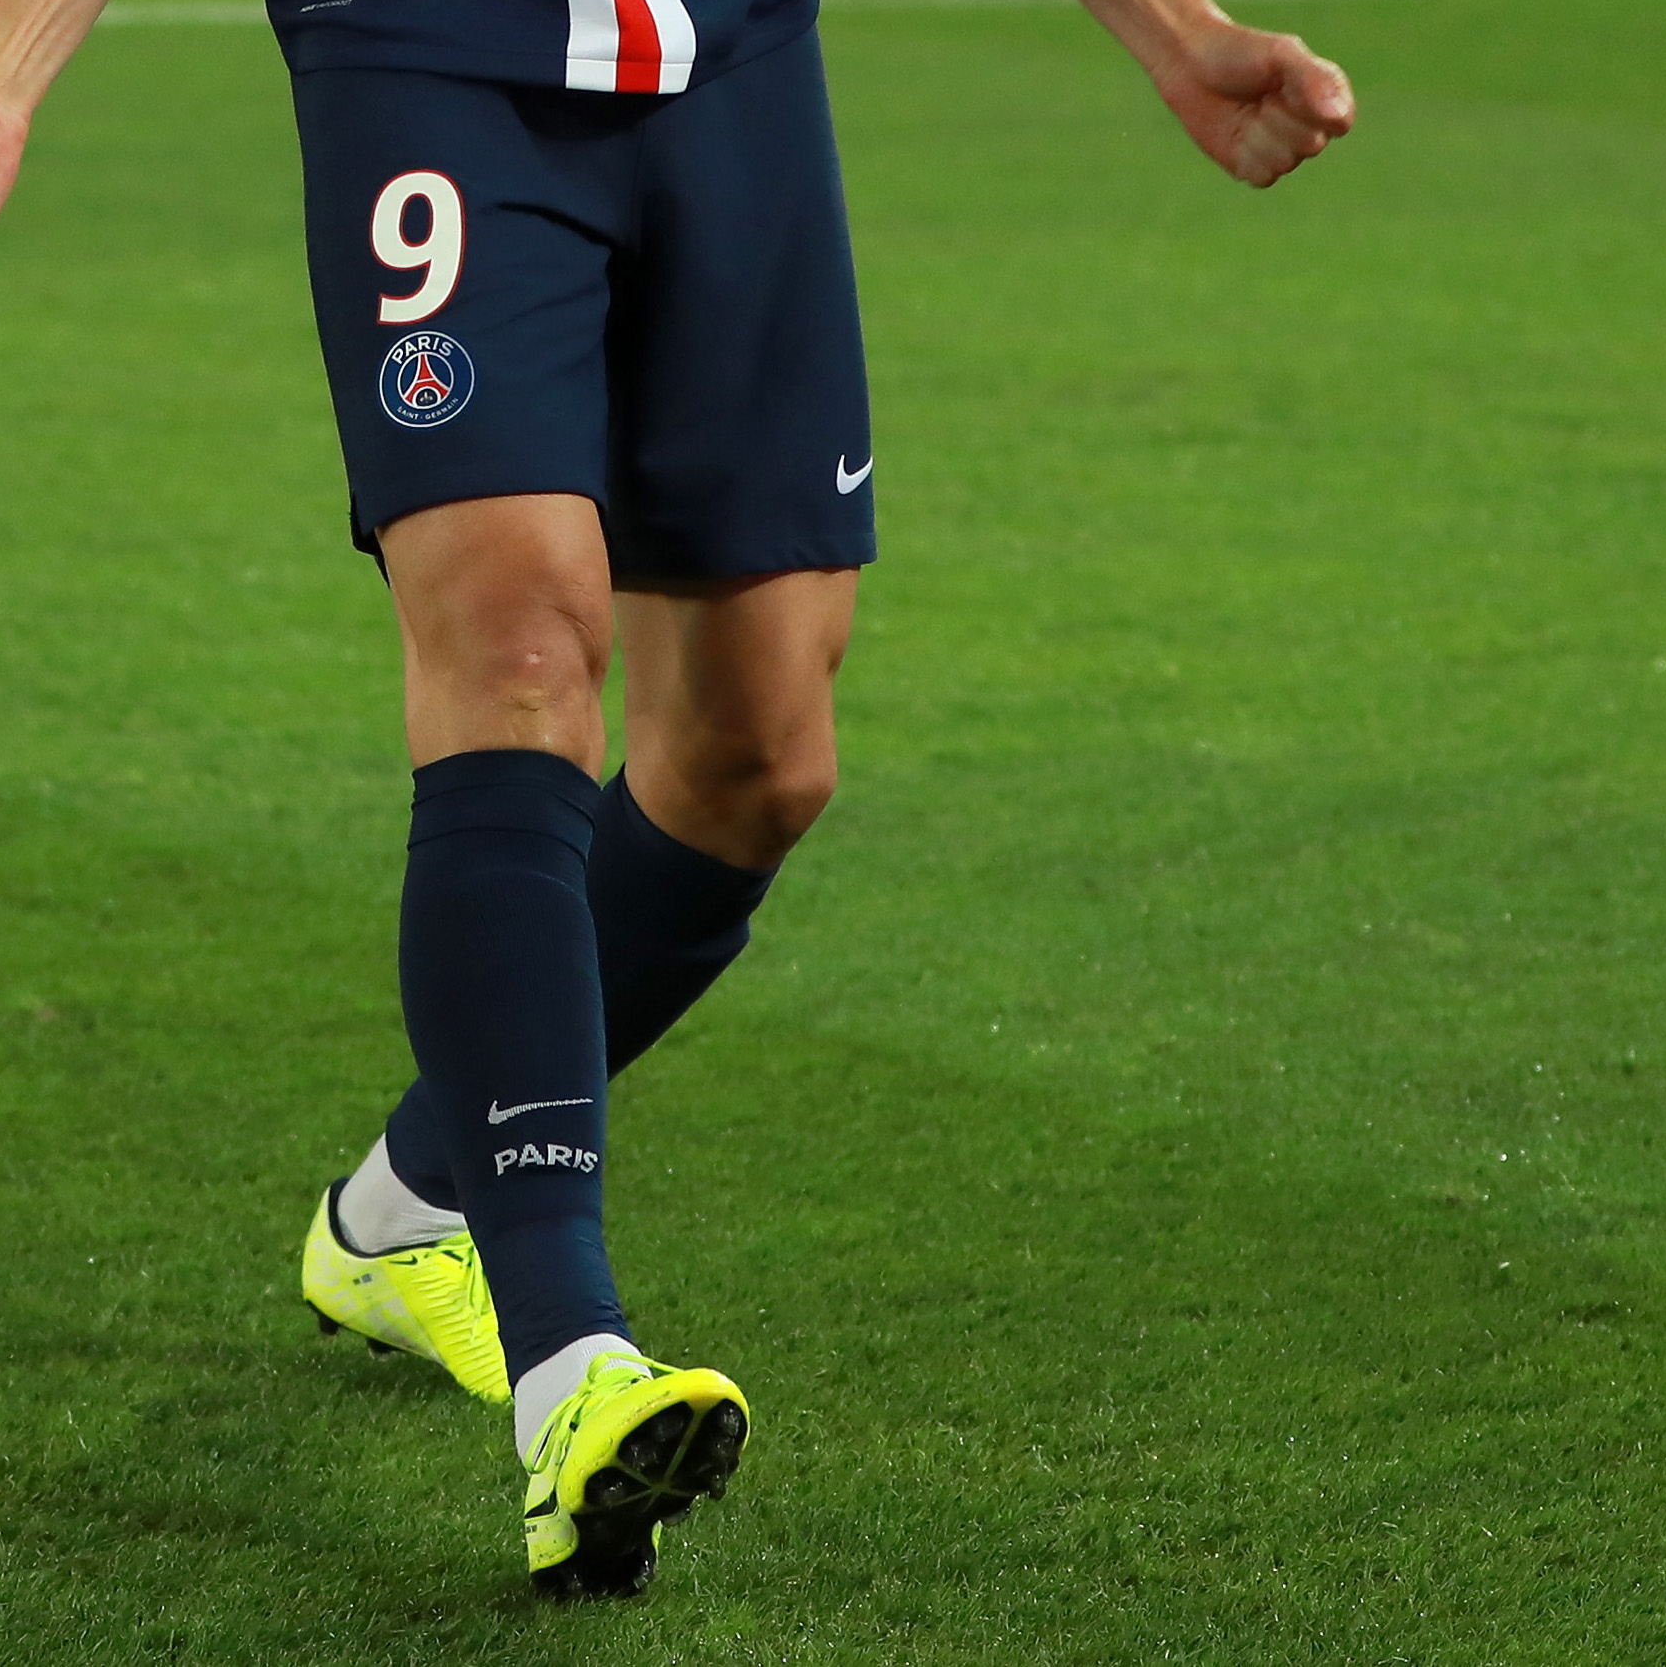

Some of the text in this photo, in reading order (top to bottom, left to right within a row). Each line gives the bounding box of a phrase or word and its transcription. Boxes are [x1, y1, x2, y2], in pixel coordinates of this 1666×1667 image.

[370, 169, 466, 325] 9
[391, 335, 454, 365] PARIS
[396, 405, 419, 420] SAINT
[494, 1143, 598, 1176] PARIS
